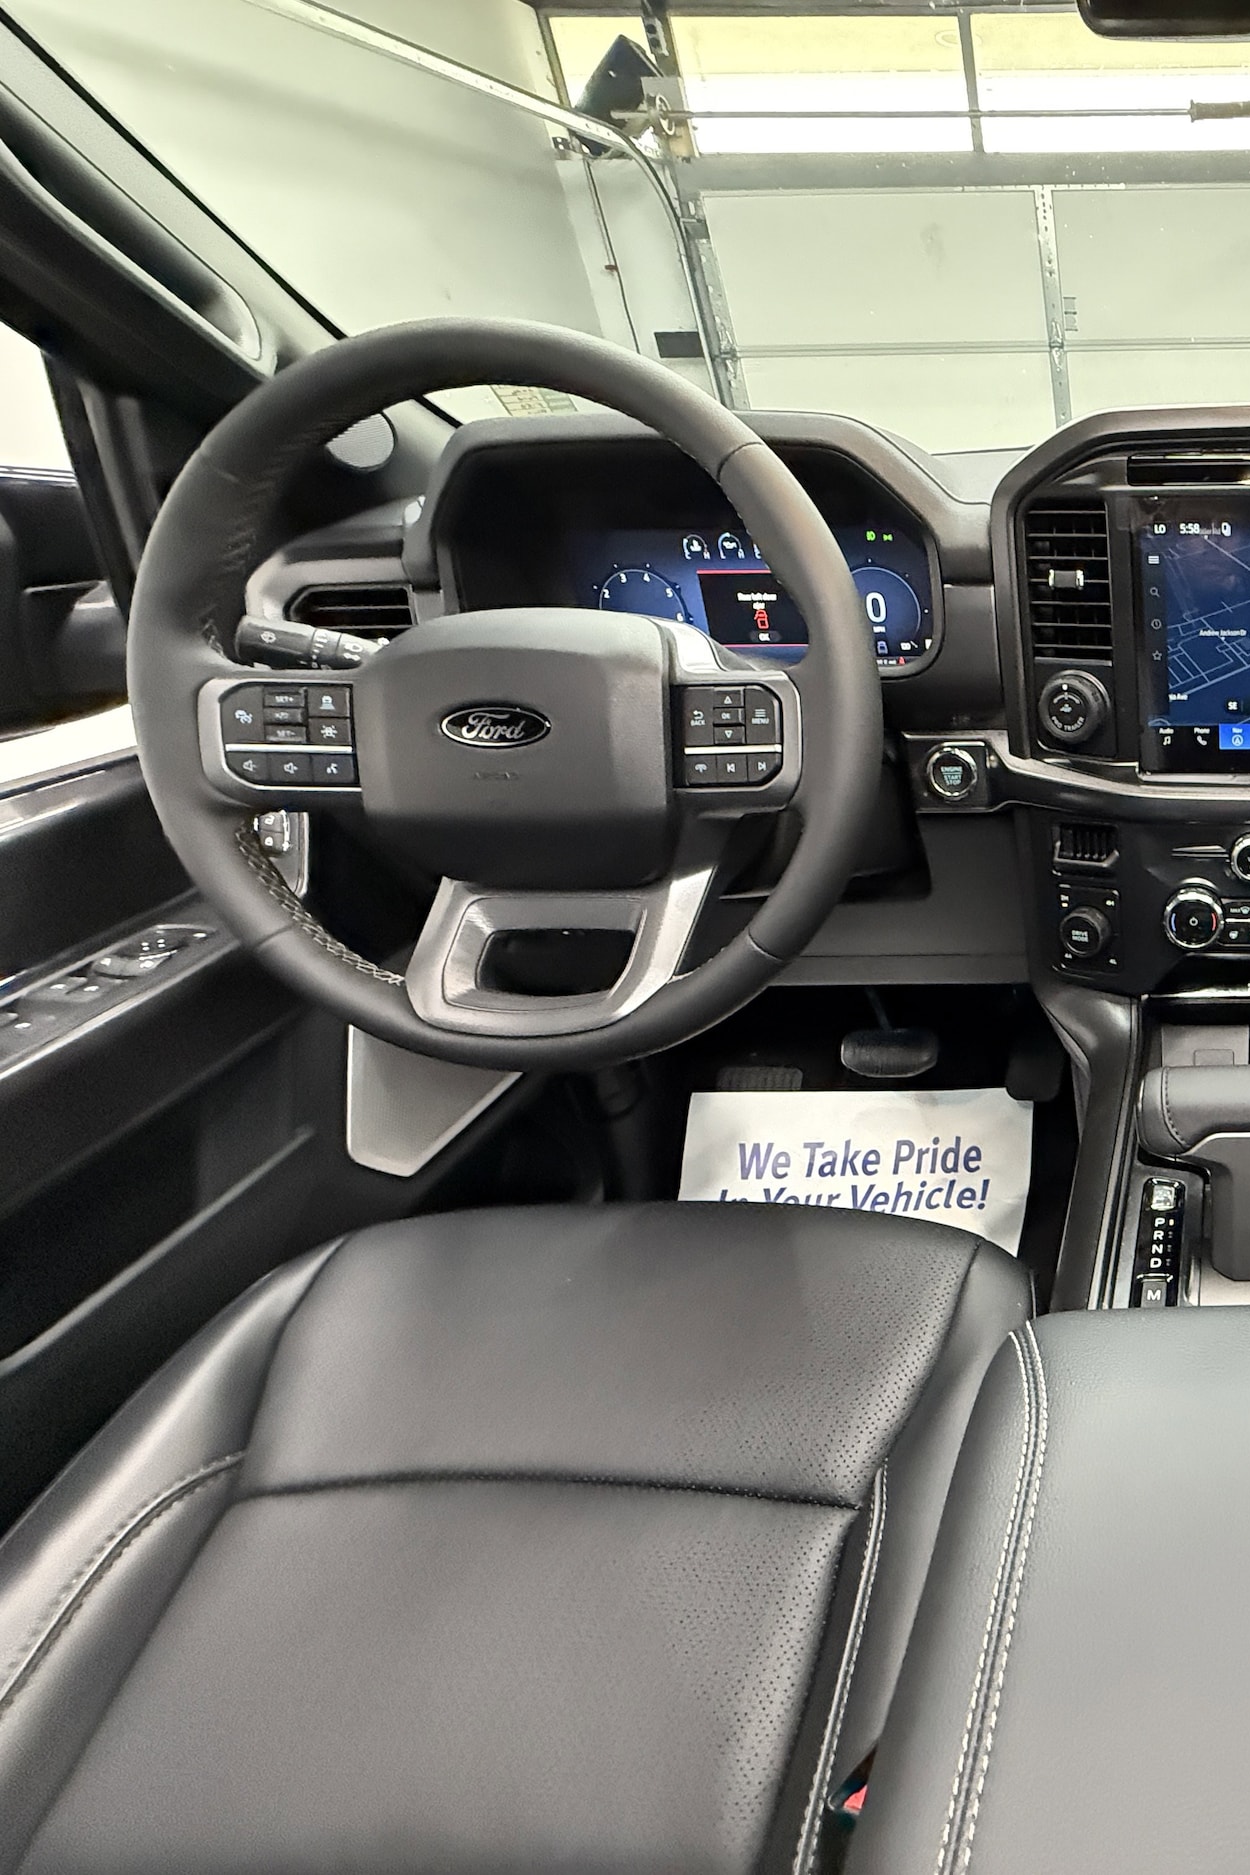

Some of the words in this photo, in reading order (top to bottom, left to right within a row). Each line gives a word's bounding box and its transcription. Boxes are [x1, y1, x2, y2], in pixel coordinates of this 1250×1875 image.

[1180, 523, 1200, 534] 5:58
[620, 573, 627, 583] 3
[643, 573, 650, 582] 4
[603, 589, 610, 598] 2
[665, 587, 673, 598] 5
[866, 592, 887, 623] 0
[676, 613, 684, 621] 6
[1228, 701, 1238, 710] SE
[462, 712, 526, 739] Ford
[1051, 716, 1063, 730] PRO
[1064, 716, 1085, 732] TRAILER
[738, 1142, 791, 1180] We
[803, 1139, 881, 1178] Take
[893, 1136, 982, 1175] Pride
[850, 1179, 990, 1214] Vehicle!
[1155, 1218, 1165, 1228] P
[1153, 1230, 1164, 1240] R
[1151, 1244, 1163, 1254] N
[1150, 1258, 1162, 1268] D
[1147, 1289, 1161, 1301] M
